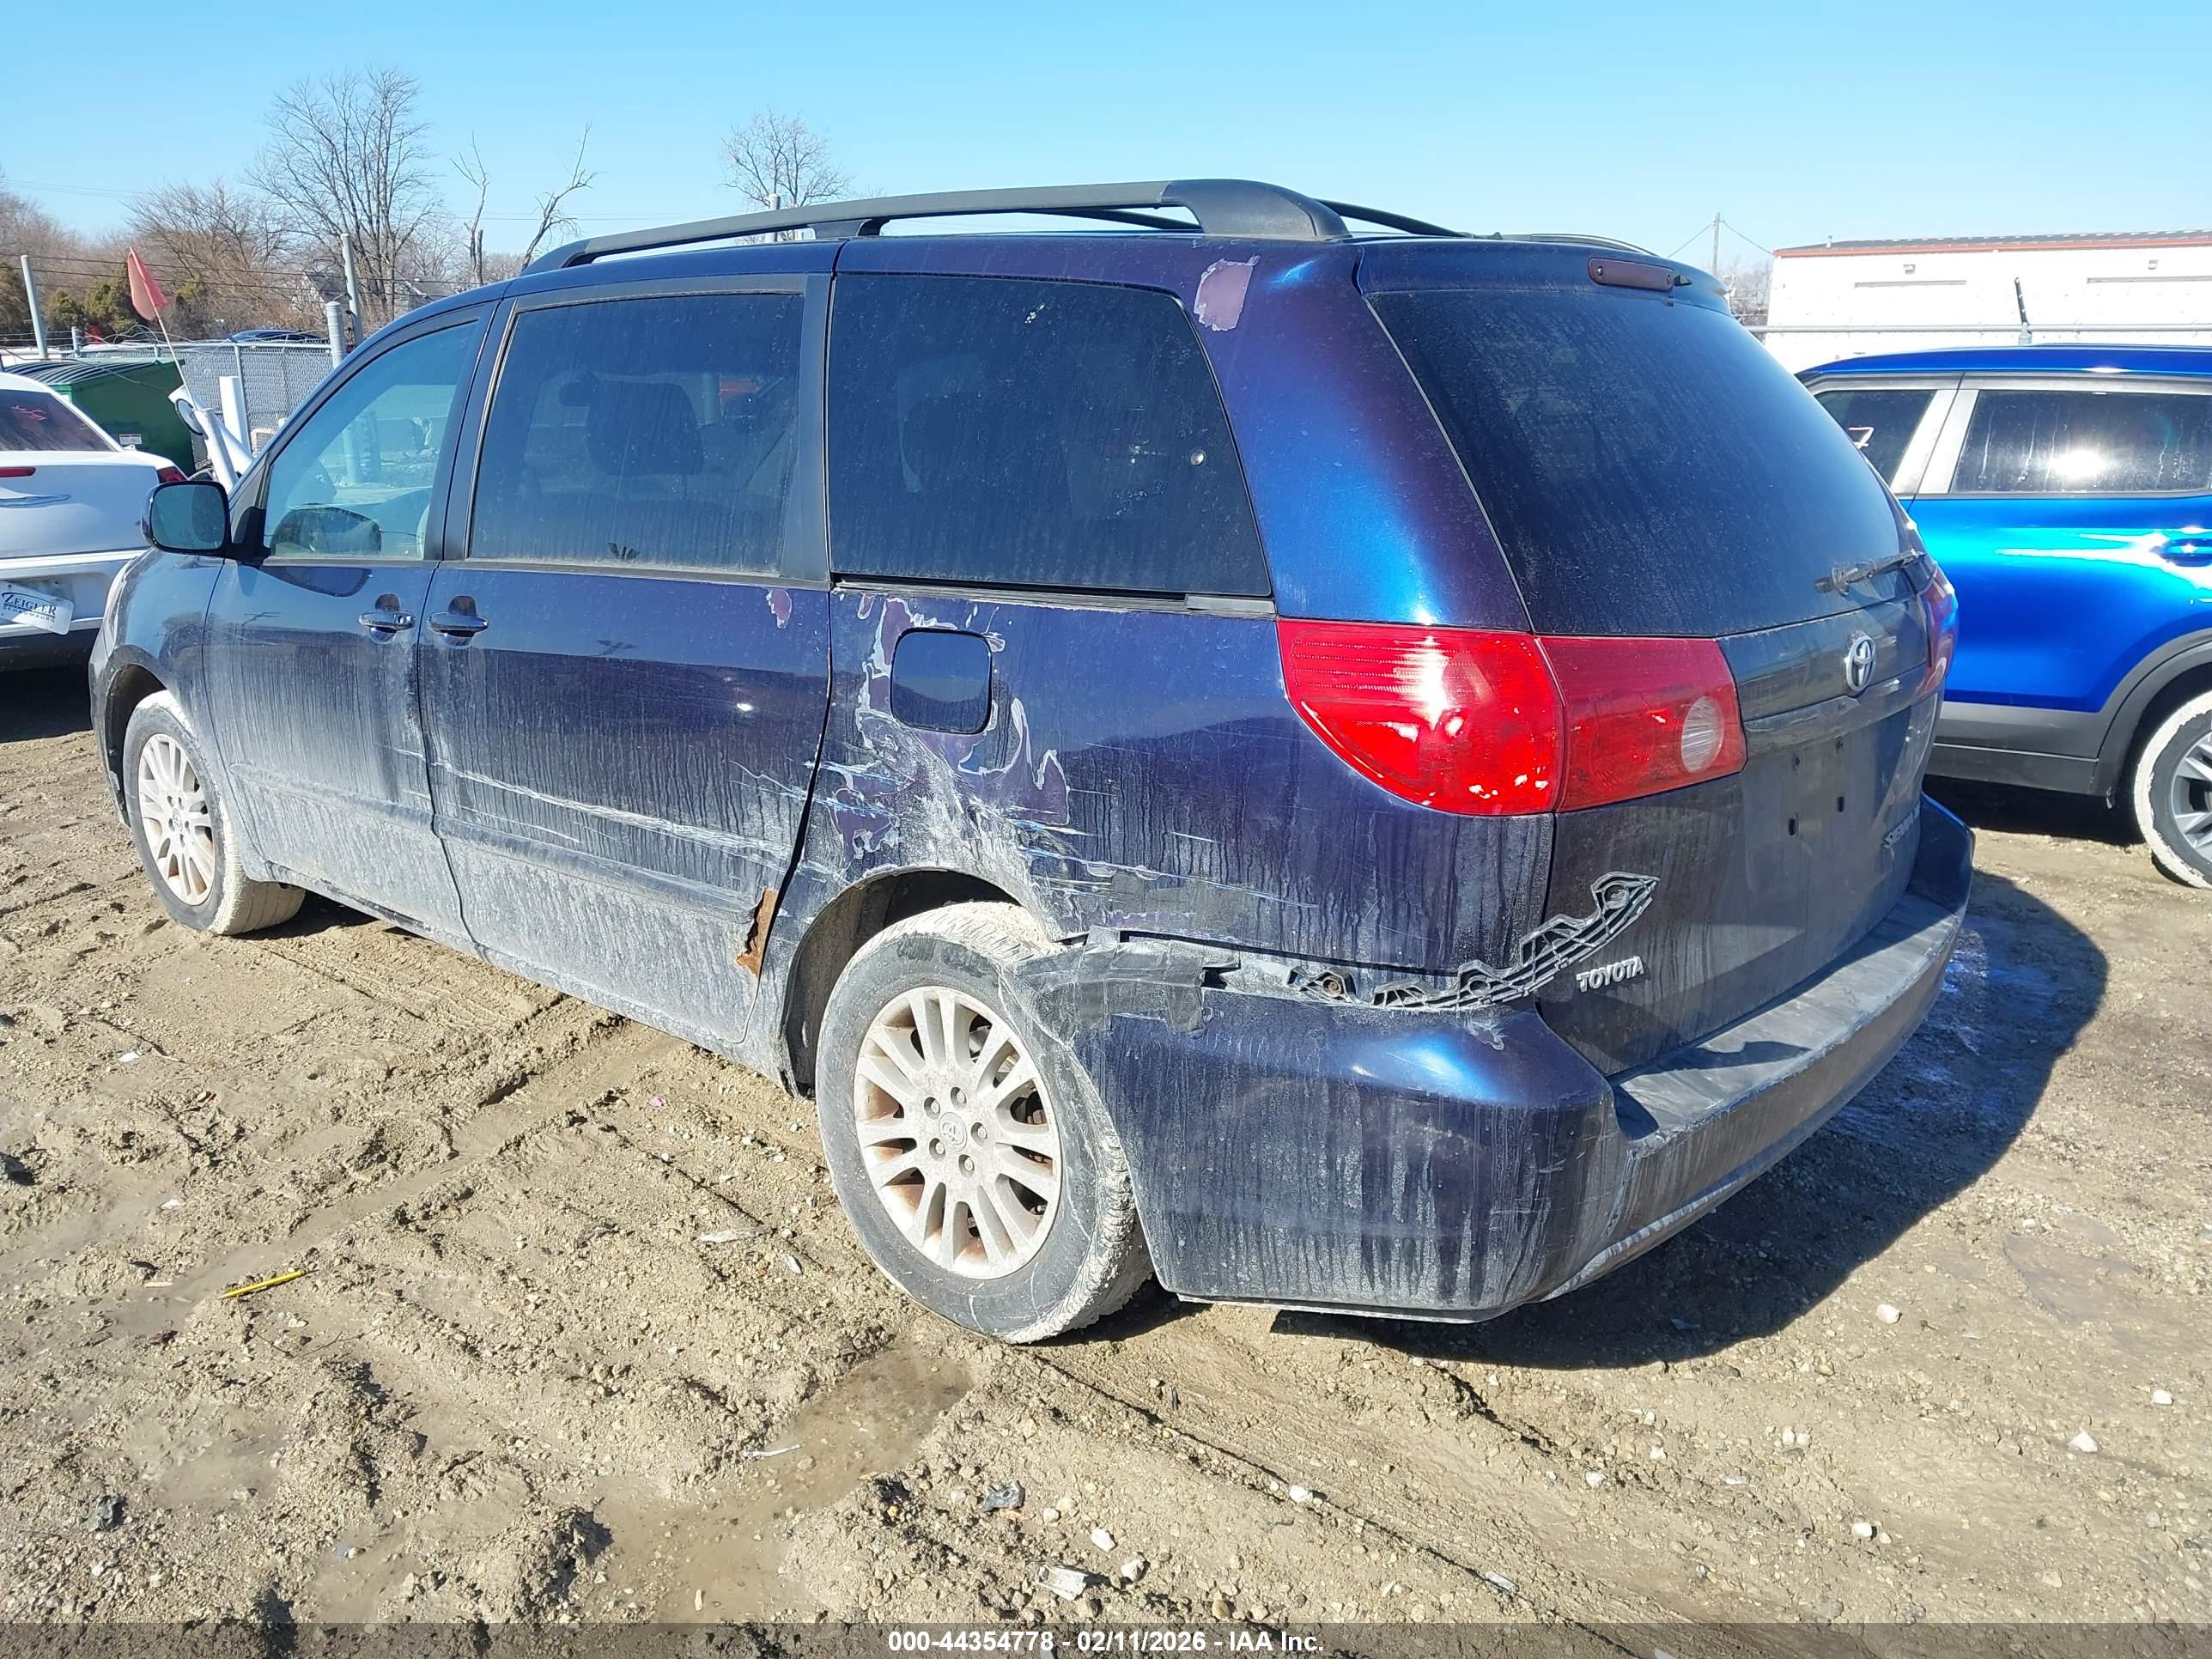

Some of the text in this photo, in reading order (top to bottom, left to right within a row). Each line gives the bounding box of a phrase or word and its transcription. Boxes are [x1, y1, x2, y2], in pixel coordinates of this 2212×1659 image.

[2, 592, 57, 616] ZEIGLER
[3, 605, 55, 623] SCHAUMBURG
[1576, 956, 1644, 993] TOYOTA
